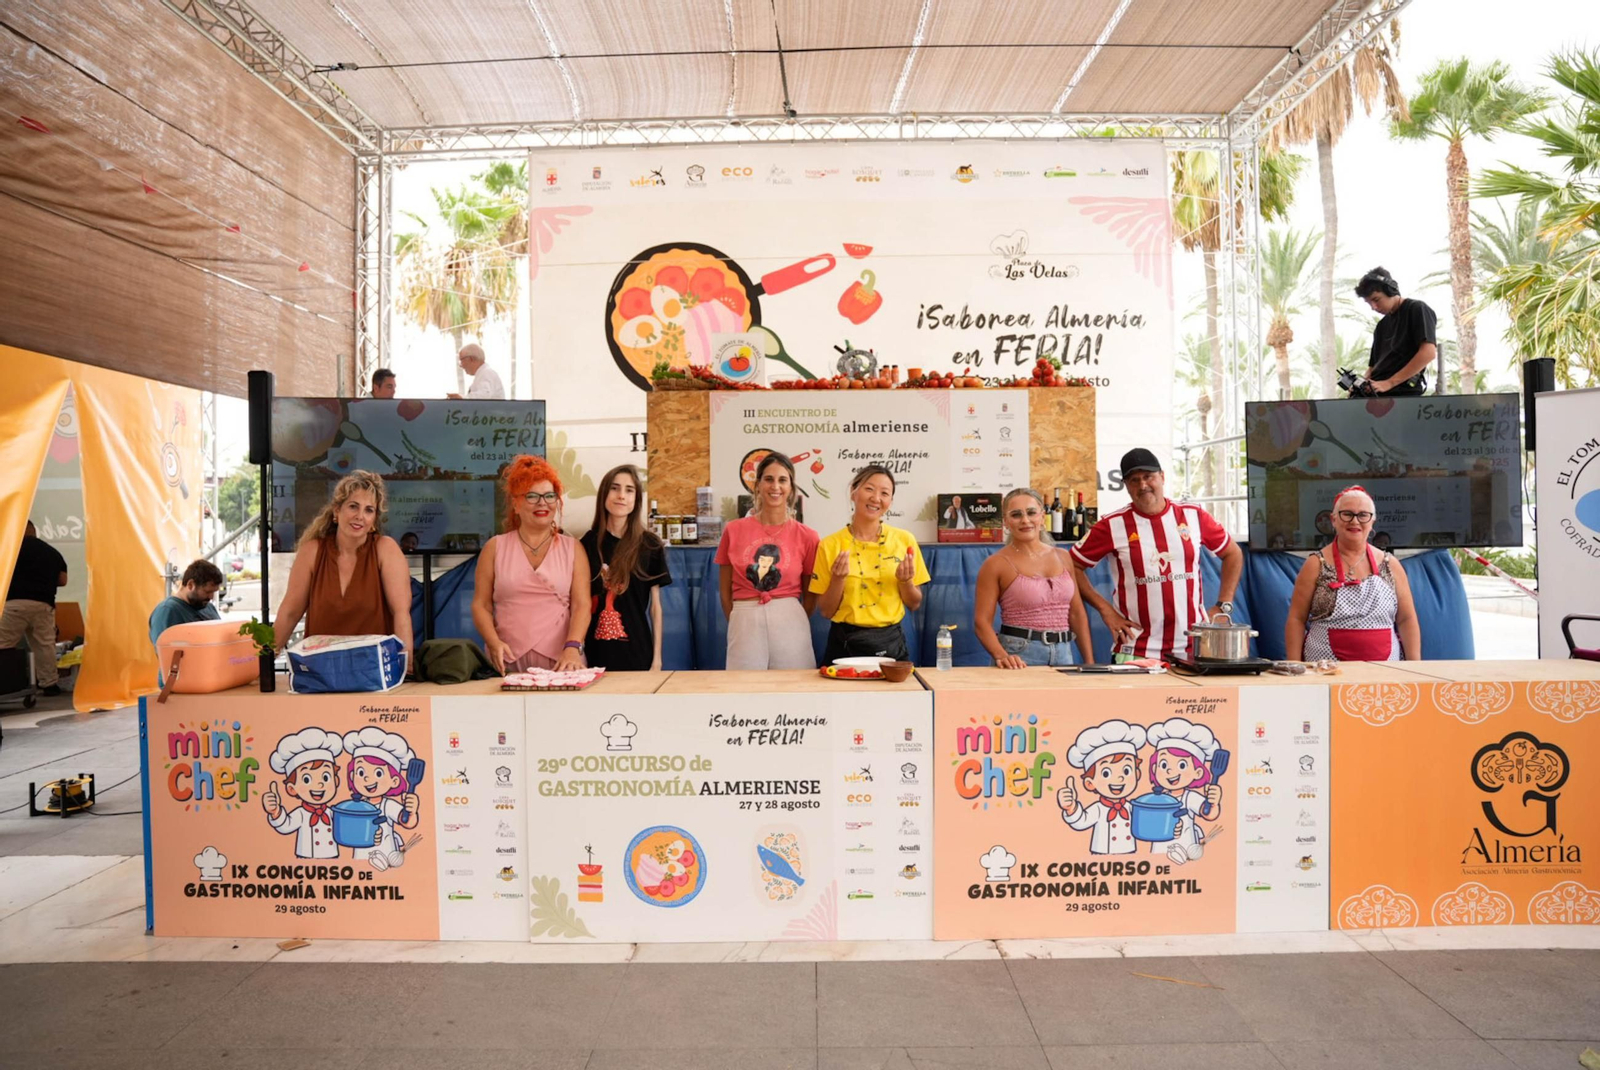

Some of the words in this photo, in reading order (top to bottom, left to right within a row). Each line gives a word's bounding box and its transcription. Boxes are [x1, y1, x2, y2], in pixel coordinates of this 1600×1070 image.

[721, 166, 753, 177] eco
[1005, 264, 1025, 281] Las
[1030, 263, 1069, 279] Velas
[1045, 304, 1146, 330] Almería
[952, 348, 983, 367] en
[743, 409, 755, 418] III
[757, 408, 822, 418] ENCUENTRO
[824, 408, 837, 417] DE
[743, 421, 840, 434] GASTRONOMÍA
[843, 420, 929, 433] almeriense
[468, 437, 486, 448] en
[1441, 431, 1461, 442] en
[471, 452, 485, 460] del
[499, 452, 506, 460] al
[888, 448, 929, 459] Almería
[1444, 447, 1459, 455] del
[1474, 446, 1483, 454] al
[1498, 445, 1511, 454] de
[1557, 470, 1573, 486] EL
[969, 504, 997, 513] Lobello
[1185, 704, 1216, 714] FERIA!
[379, 713, 408, 723] FERIA!
[774, 714, 828, 727] Almería
[167, 721, 242, 760] mini
[727, 736, 743, 746] en
[747, 728, 805, 745] FERIA!
[957, 714, 1038, 755] mini
[571, 755, 686, 772] CONCURSO
[689, 755, 712, 772] de
[538, 776, 696, 797] GASTRONOMÍA
[700, 780, 821, 796] ALMERIENSE
[1248, 786, 1271, 795] eco
[445, 796, 468, 805] eco
[847, 794, 872, 803] eco
[739, 801, 753, 810] 27
[755, 803, 763, 812] y
[764, 800, 778, 809] 28
[780, 800, 820, 811] agosto
[1461, 828, 1582, 864] Almería
[232, 864, 249, 879] IX
[256, 865, 354, 880] CONCURSO
[359, 871, 372, 881] DE
[1021, 863, 1039, 878] IX
[1047, 860, 1151, 877] CONCURSO
[1156, 865, 1170, 875] DE
[1461, 867, 1499, 875] Asociación
[1502, 867, 1529, 875] Almería
[1532, 866, 1582, 875] Gastronómica
[184, 881, 316, 900] GASTRONOMÍA
[323, 884, 404, 900] INFANTIL
[967, 877, 1110, 900] GASTRONOMÍA
[1118, 879, 1202, 896] INFANTIL
[275, 904, 287, 914] 29
[289, 904, 326, 915] agosto
[1066, 903, 1079, 912] 29
[1082, 901, 1120, 913] agosto
